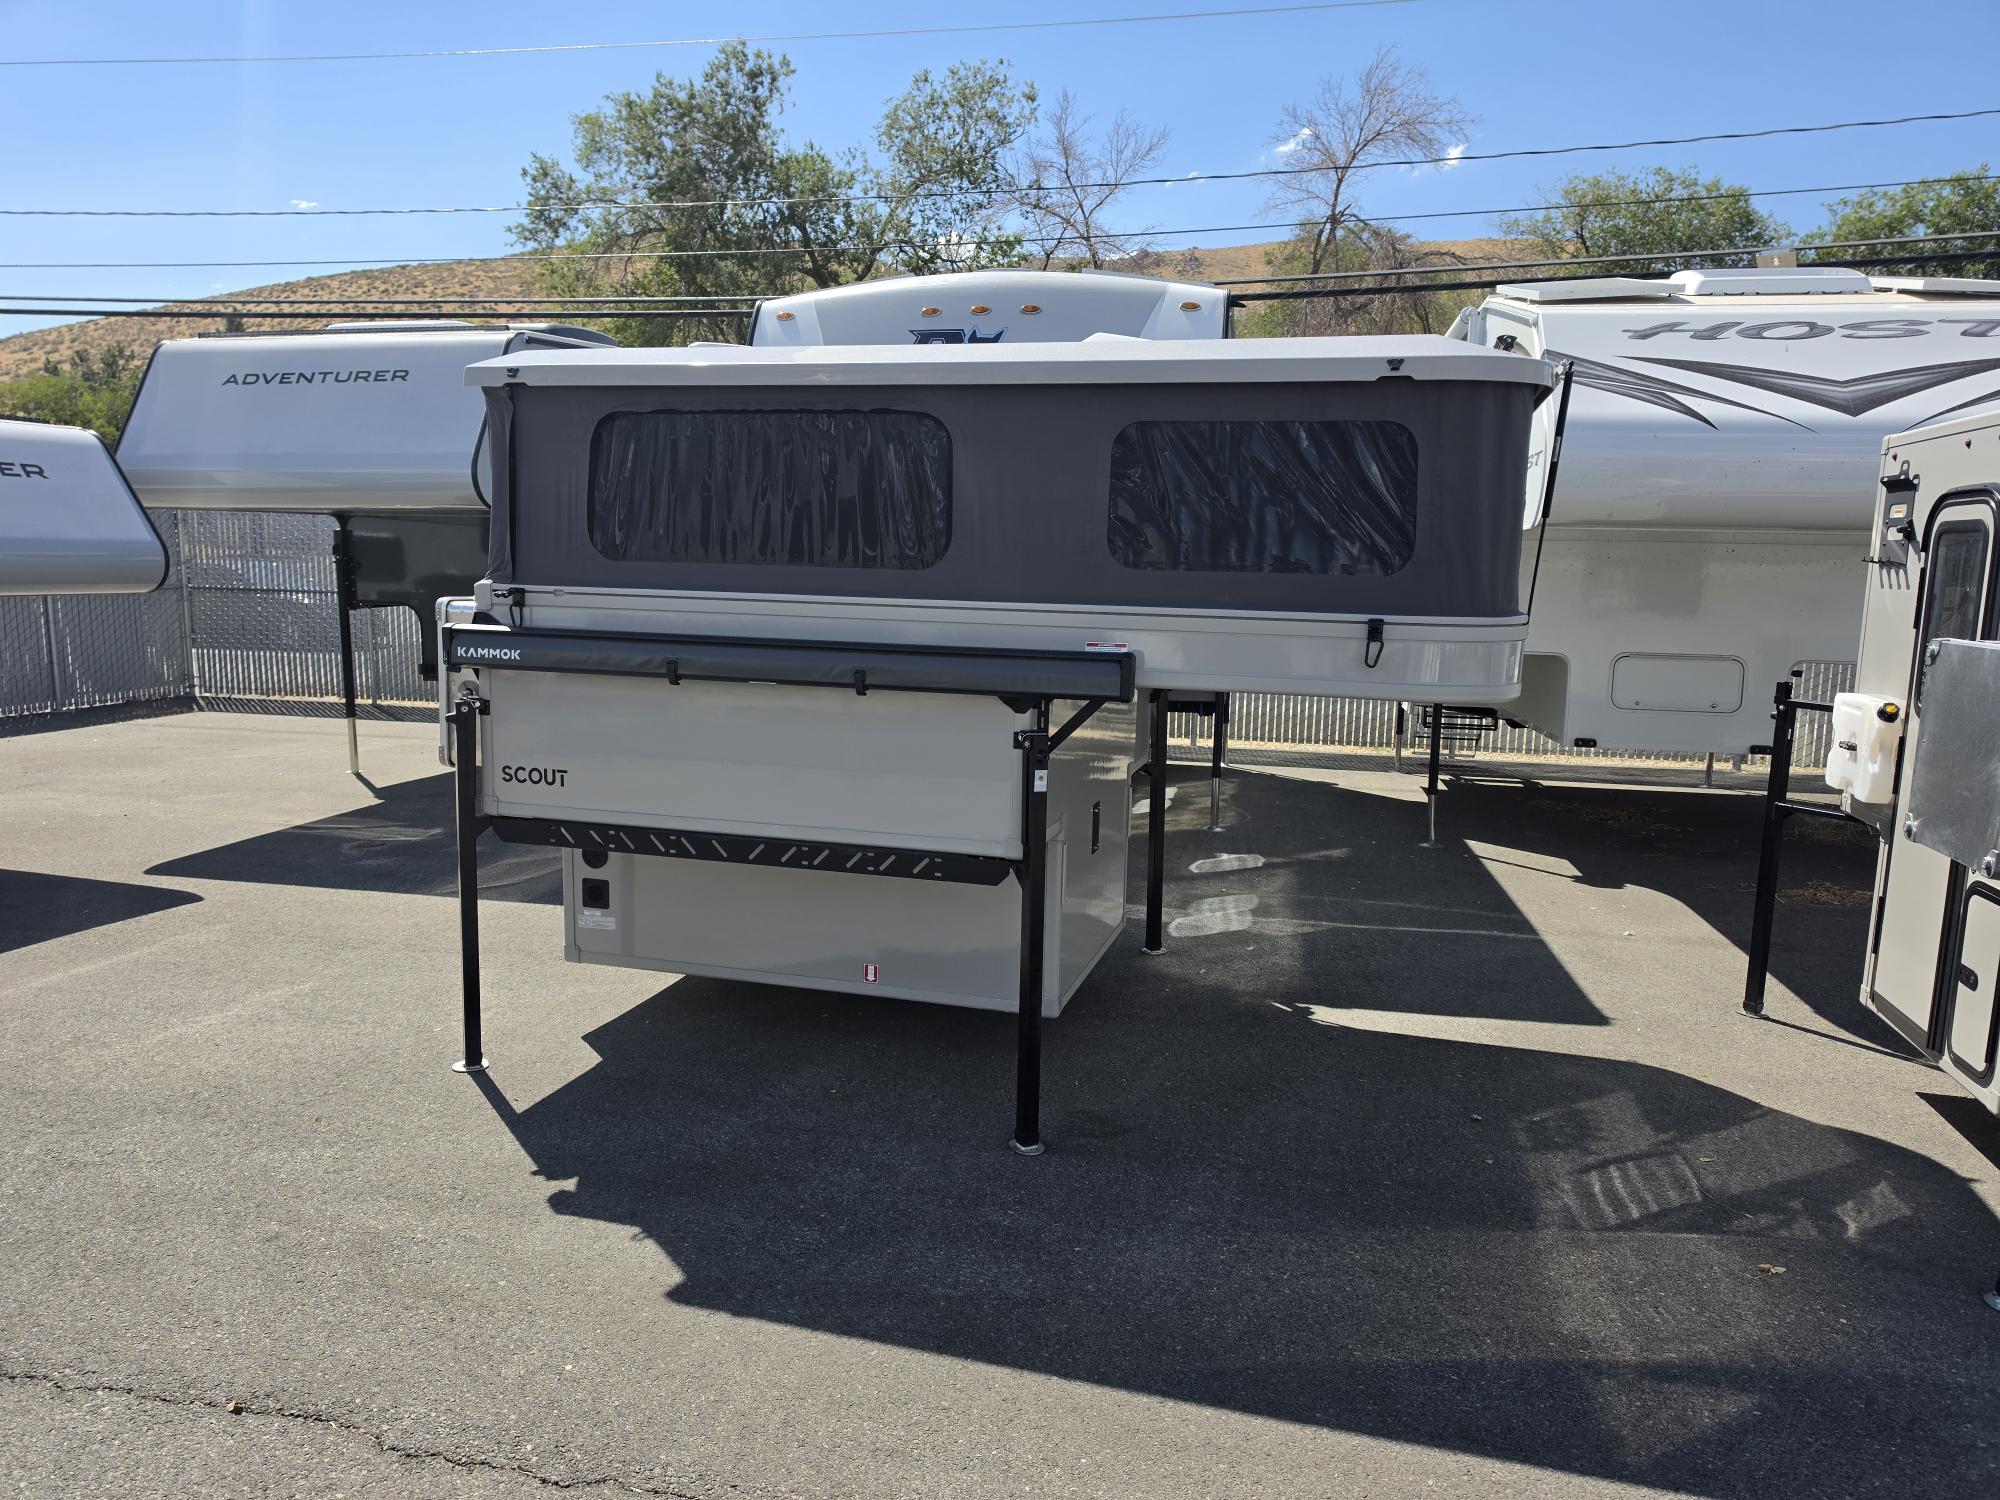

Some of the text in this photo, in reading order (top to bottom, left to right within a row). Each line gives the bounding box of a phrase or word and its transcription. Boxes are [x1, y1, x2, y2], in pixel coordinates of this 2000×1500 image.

[1621, 318, 2000, 341] HOST
[222, 369, 410, 386] ADVENTURER
[457, 646, 521, 660] KAMMOK
[501, 765, 568, 788] SCOUT
